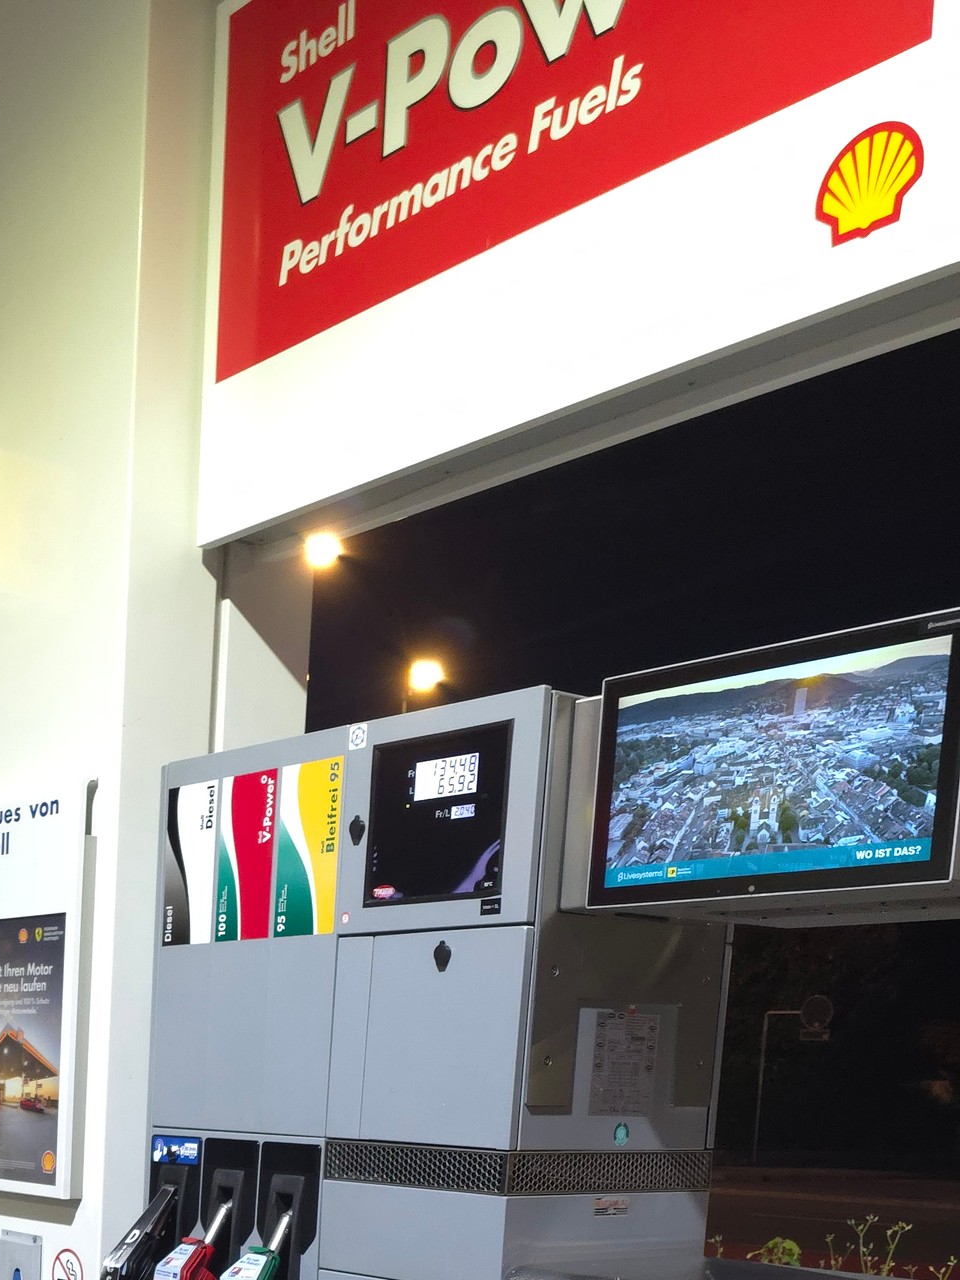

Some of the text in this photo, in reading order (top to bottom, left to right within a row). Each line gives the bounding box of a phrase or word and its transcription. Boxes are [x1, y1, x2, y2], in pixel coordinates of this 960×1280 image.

[279, 0, 355, 83] Shell
[278, 55, 644, 287] Performance Fuels
[29, 799, 60, 818] von
[205, 785, 215, 829] Diesel
[262, 777, 275, 843] V-Power
[325, 762, 340, 853] Bleifrei 95
[856, 845, 922, 860] WO IST DAS?
[623, 870, 663, 880] Livesystems
[164, 905, 174, 943] Diesel
[218, 914, 227, 937] 100
[277, 915, 286, 933] 95
[4, 962, 25, 977] Ihren
[26, 962, 53, 976] Motor
[3, 983, 19, 993] neu
[20, 977, 47, 992] laufen
